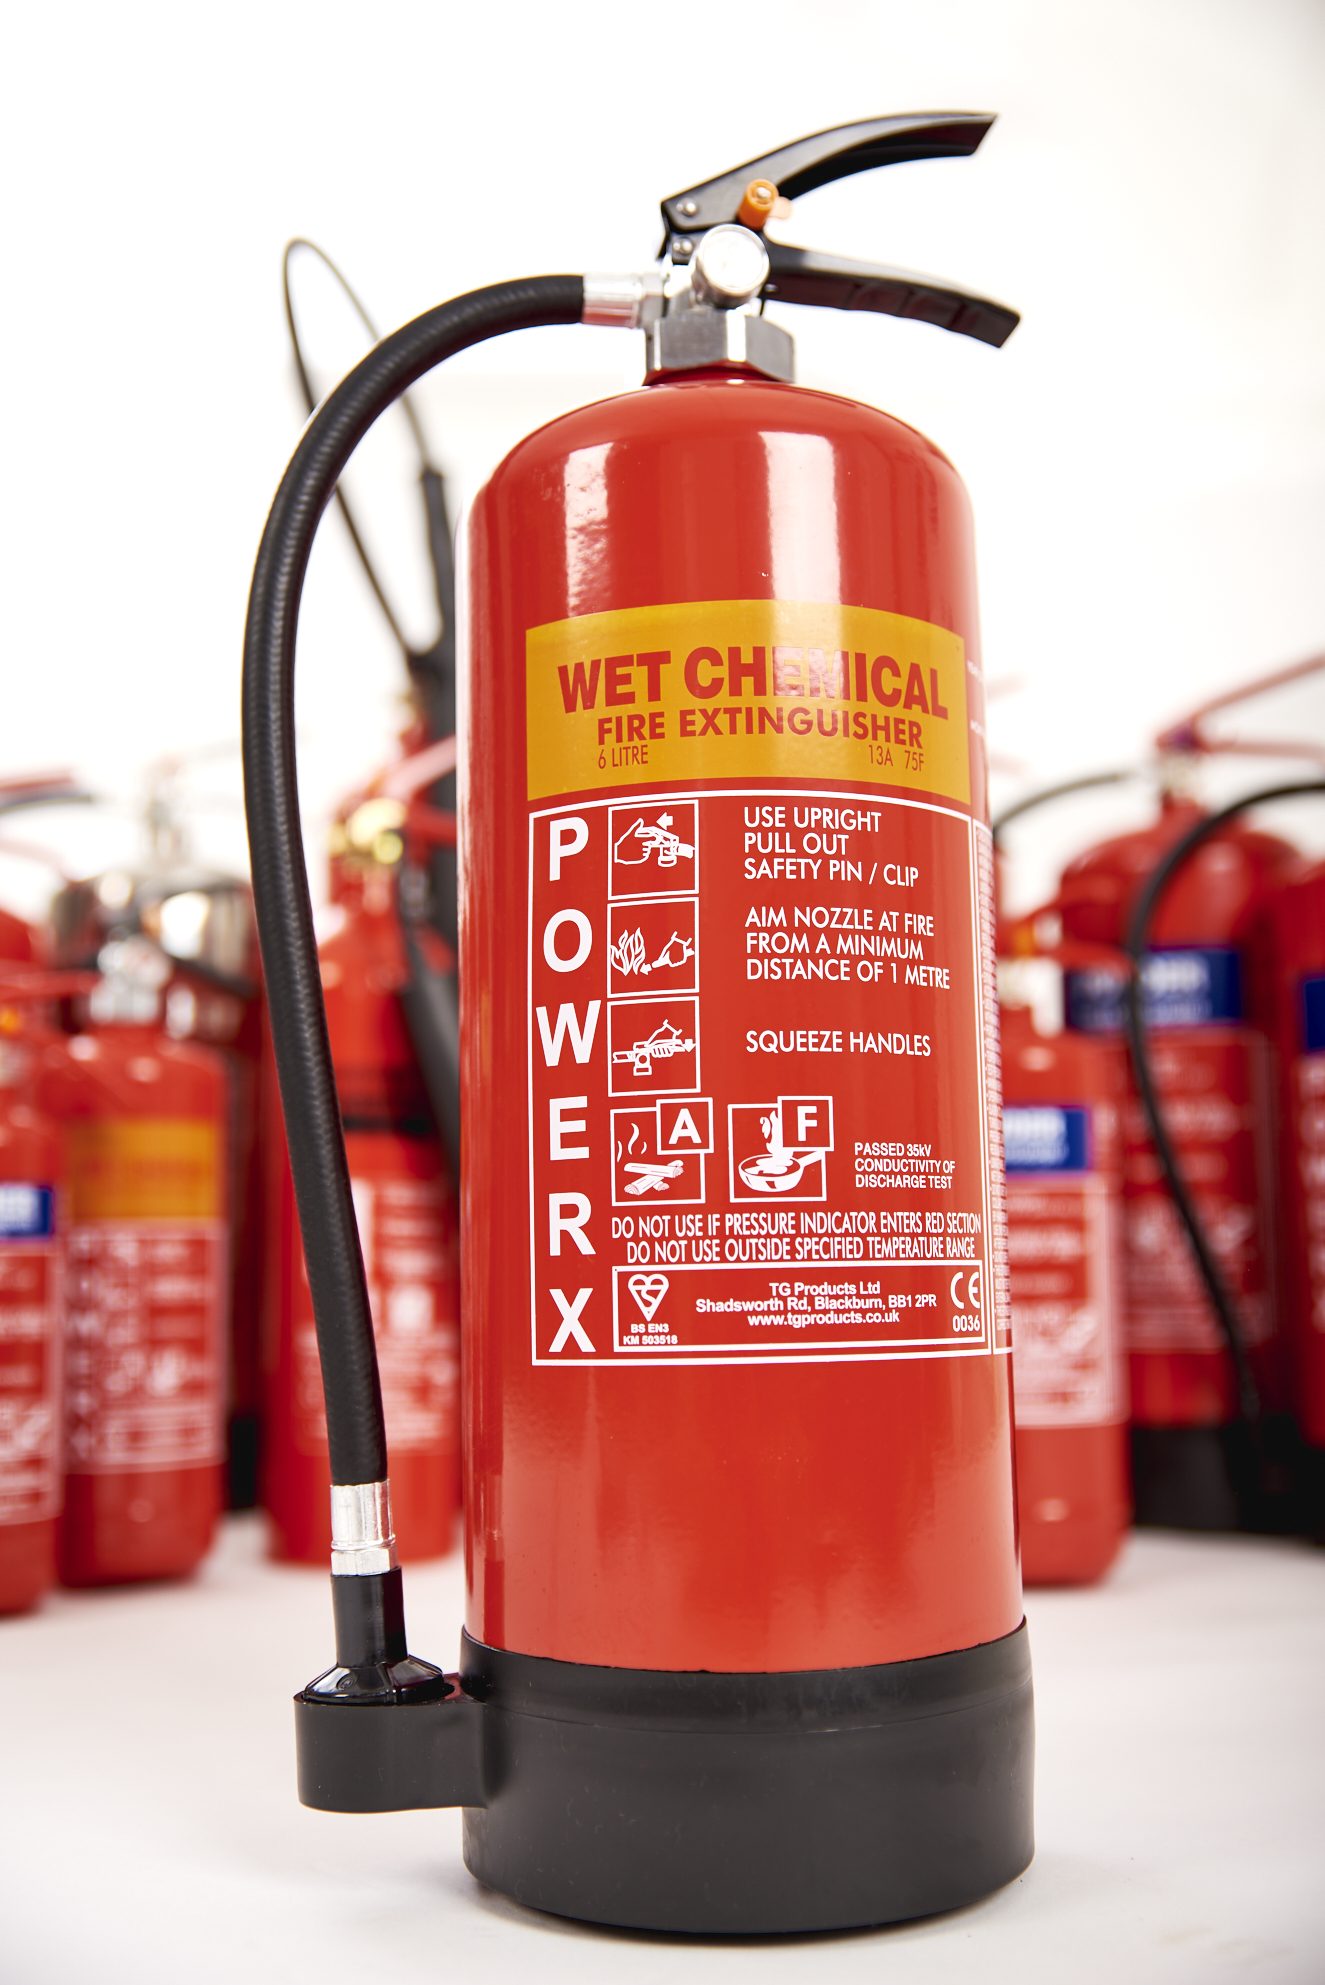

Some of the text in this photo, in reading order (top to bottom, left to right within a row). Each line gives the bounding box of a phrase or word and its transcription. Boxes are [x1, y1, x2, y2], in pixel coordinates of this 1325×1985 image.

[558, 647, 947, 723] WET CHEMICAL
[598, 707, 922, 750] FIRE EXTINGUISHER
[598, 745, 648, 769] 6 LITRE
[869, 745, 923, 770] 13A 75F
[745, 806, 881, 832] USE UPRIGHT
[745, 832, 849, 855] PULL OUT
[745, 858, 918, 887] SAFETY PIN / CLIP
[745, 906, 934, 936] AIM NOZZLE AT FIRE
[747, 932, 923, 960] FROM A MINIMUM
[747, 958, 950, 989] DISTANCE OF 1 METRE
[747, 1030, 930, 1056] SQUEEZE HANDLES
[669, 1108, 701, 1144] A
[797, 1106, 817, 1141] F
[855, 1142, 931, 1157] PASSED 35kV
[855, 1158, 955, 1173] CONDUCTIVITY OF
[856, 1174, 953, 1189] DISCHARGE TEST
[612, 1211, 981, 1238] DO NOT USE IF PRESSURE INDICATOR ENTERS RED SECTION
[627, 1237, 976, 1263] DO NOT USE OUTSIDE SPECIFIED TEMPERATURE RANGE
[769, 1281, 880, 1296] TG Products Ltd
[696, 1294, 937, 1315] Shadsworth Rd, Blackburn, BB1 2PR
[630, 1323, 669, 1333] BS EN3
[748, 1308, 899, 1328] www.tgproducts.co.uk
[953, 1315, 980, 1332] 0036
[623, 1335, 678, 1345] KM 503518
